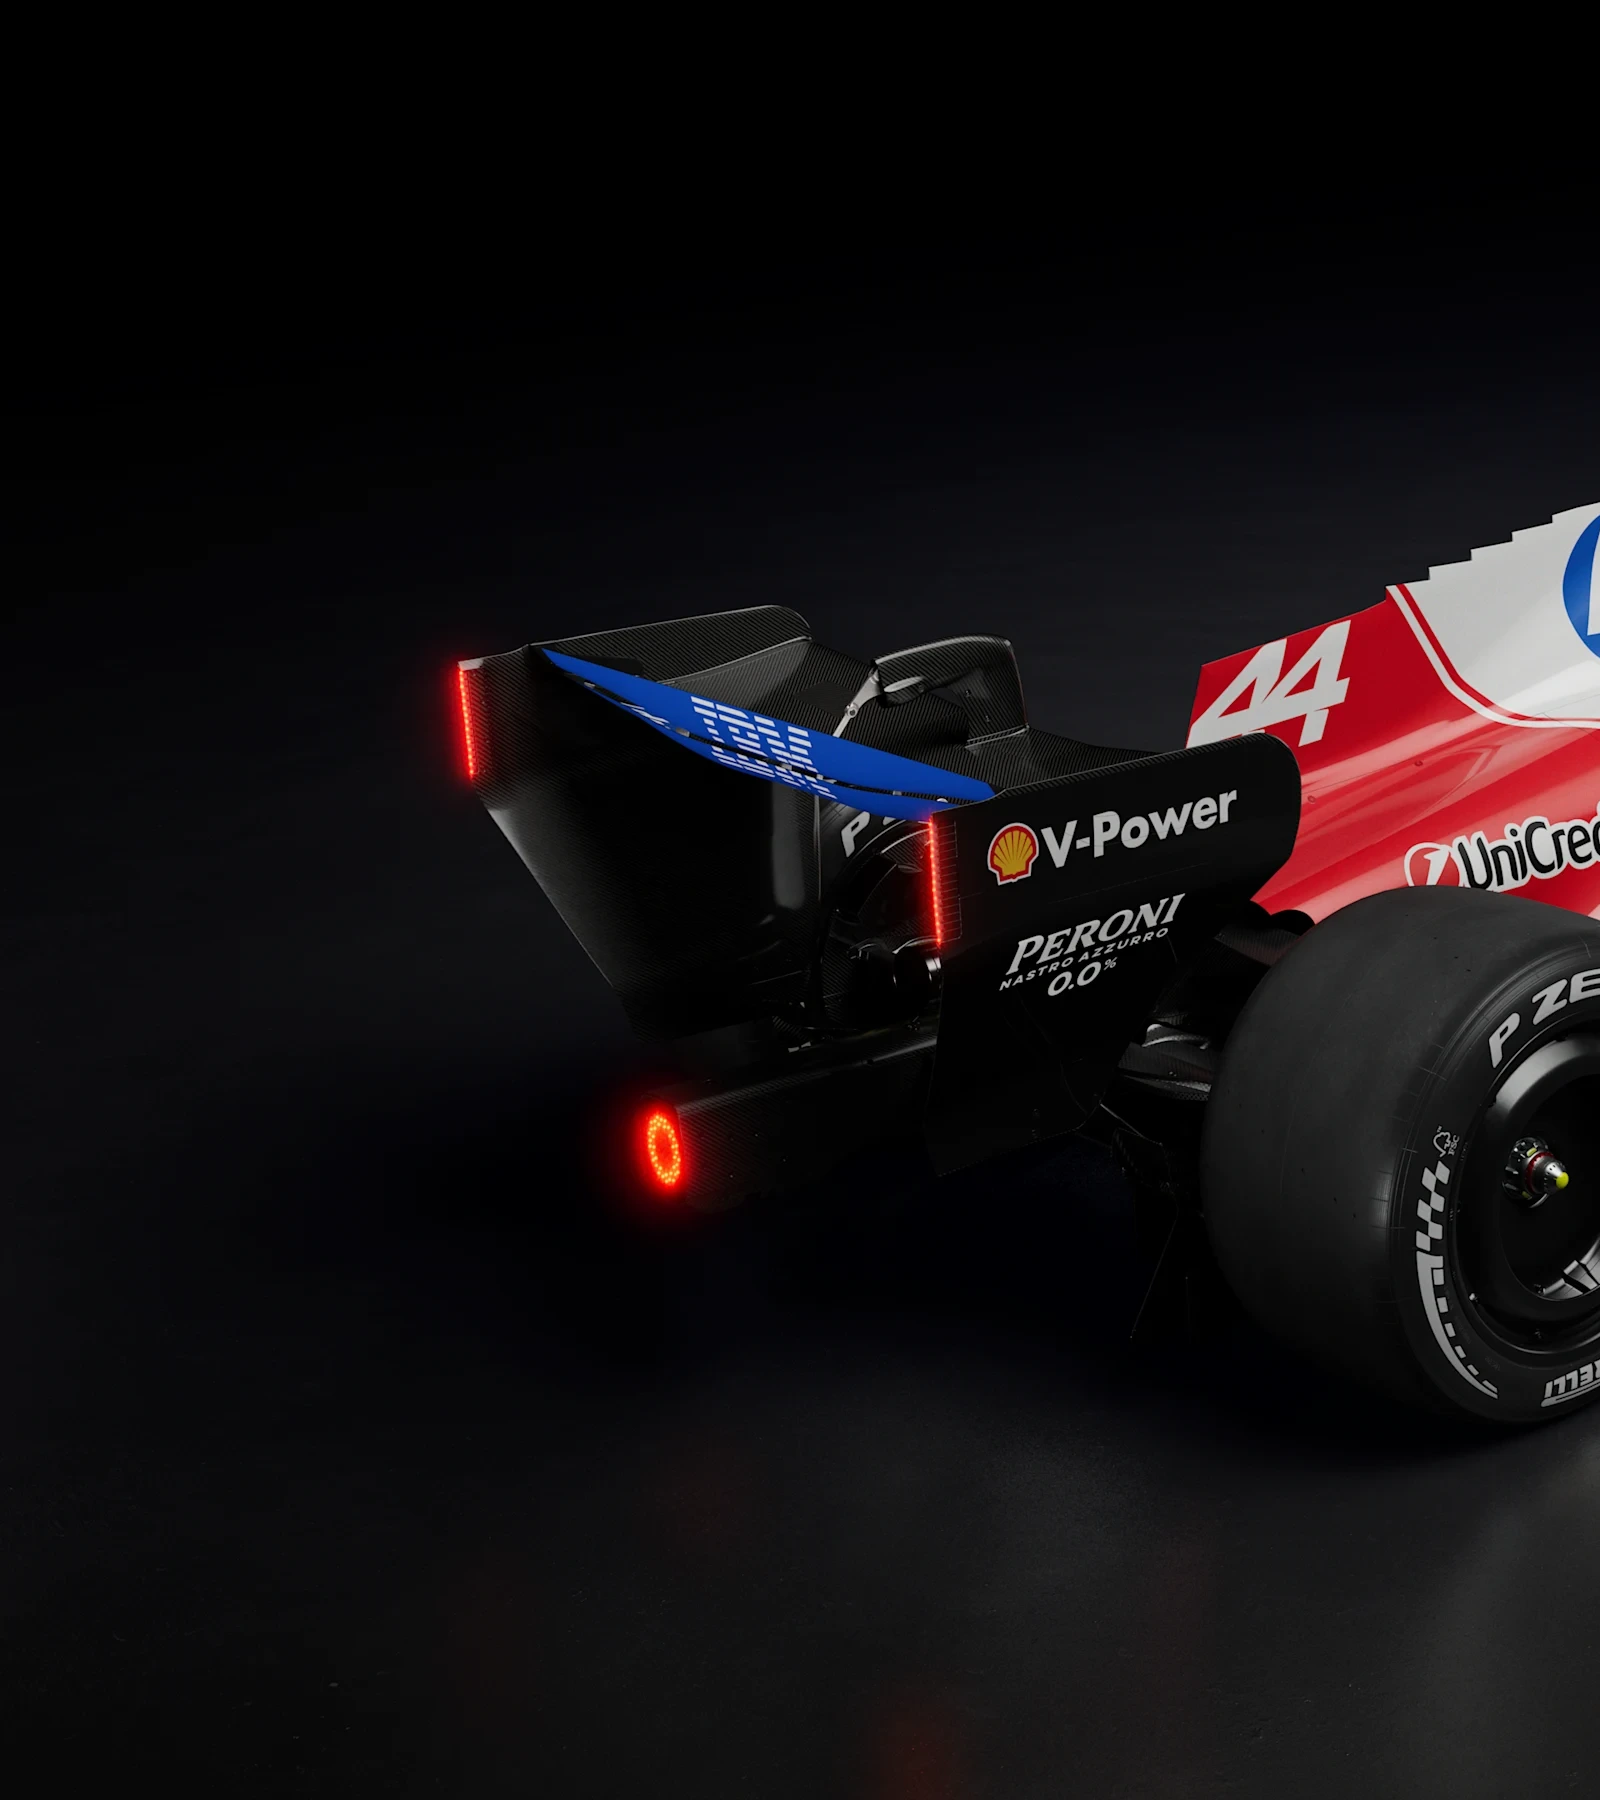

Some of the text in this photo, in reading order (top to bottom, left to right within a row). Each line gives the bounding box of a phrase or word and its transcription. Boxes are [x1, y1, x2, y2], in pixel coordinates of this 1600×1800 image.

[1186, 619, 1351, 748] 44
[1041, 790, 1238, 868] V-Power
[999, 927, 1169, 991] NASTRO AZZURRO
[1005, 893, 1186, 976] PERONI
[1489, 1012, 1521, 1069] P
